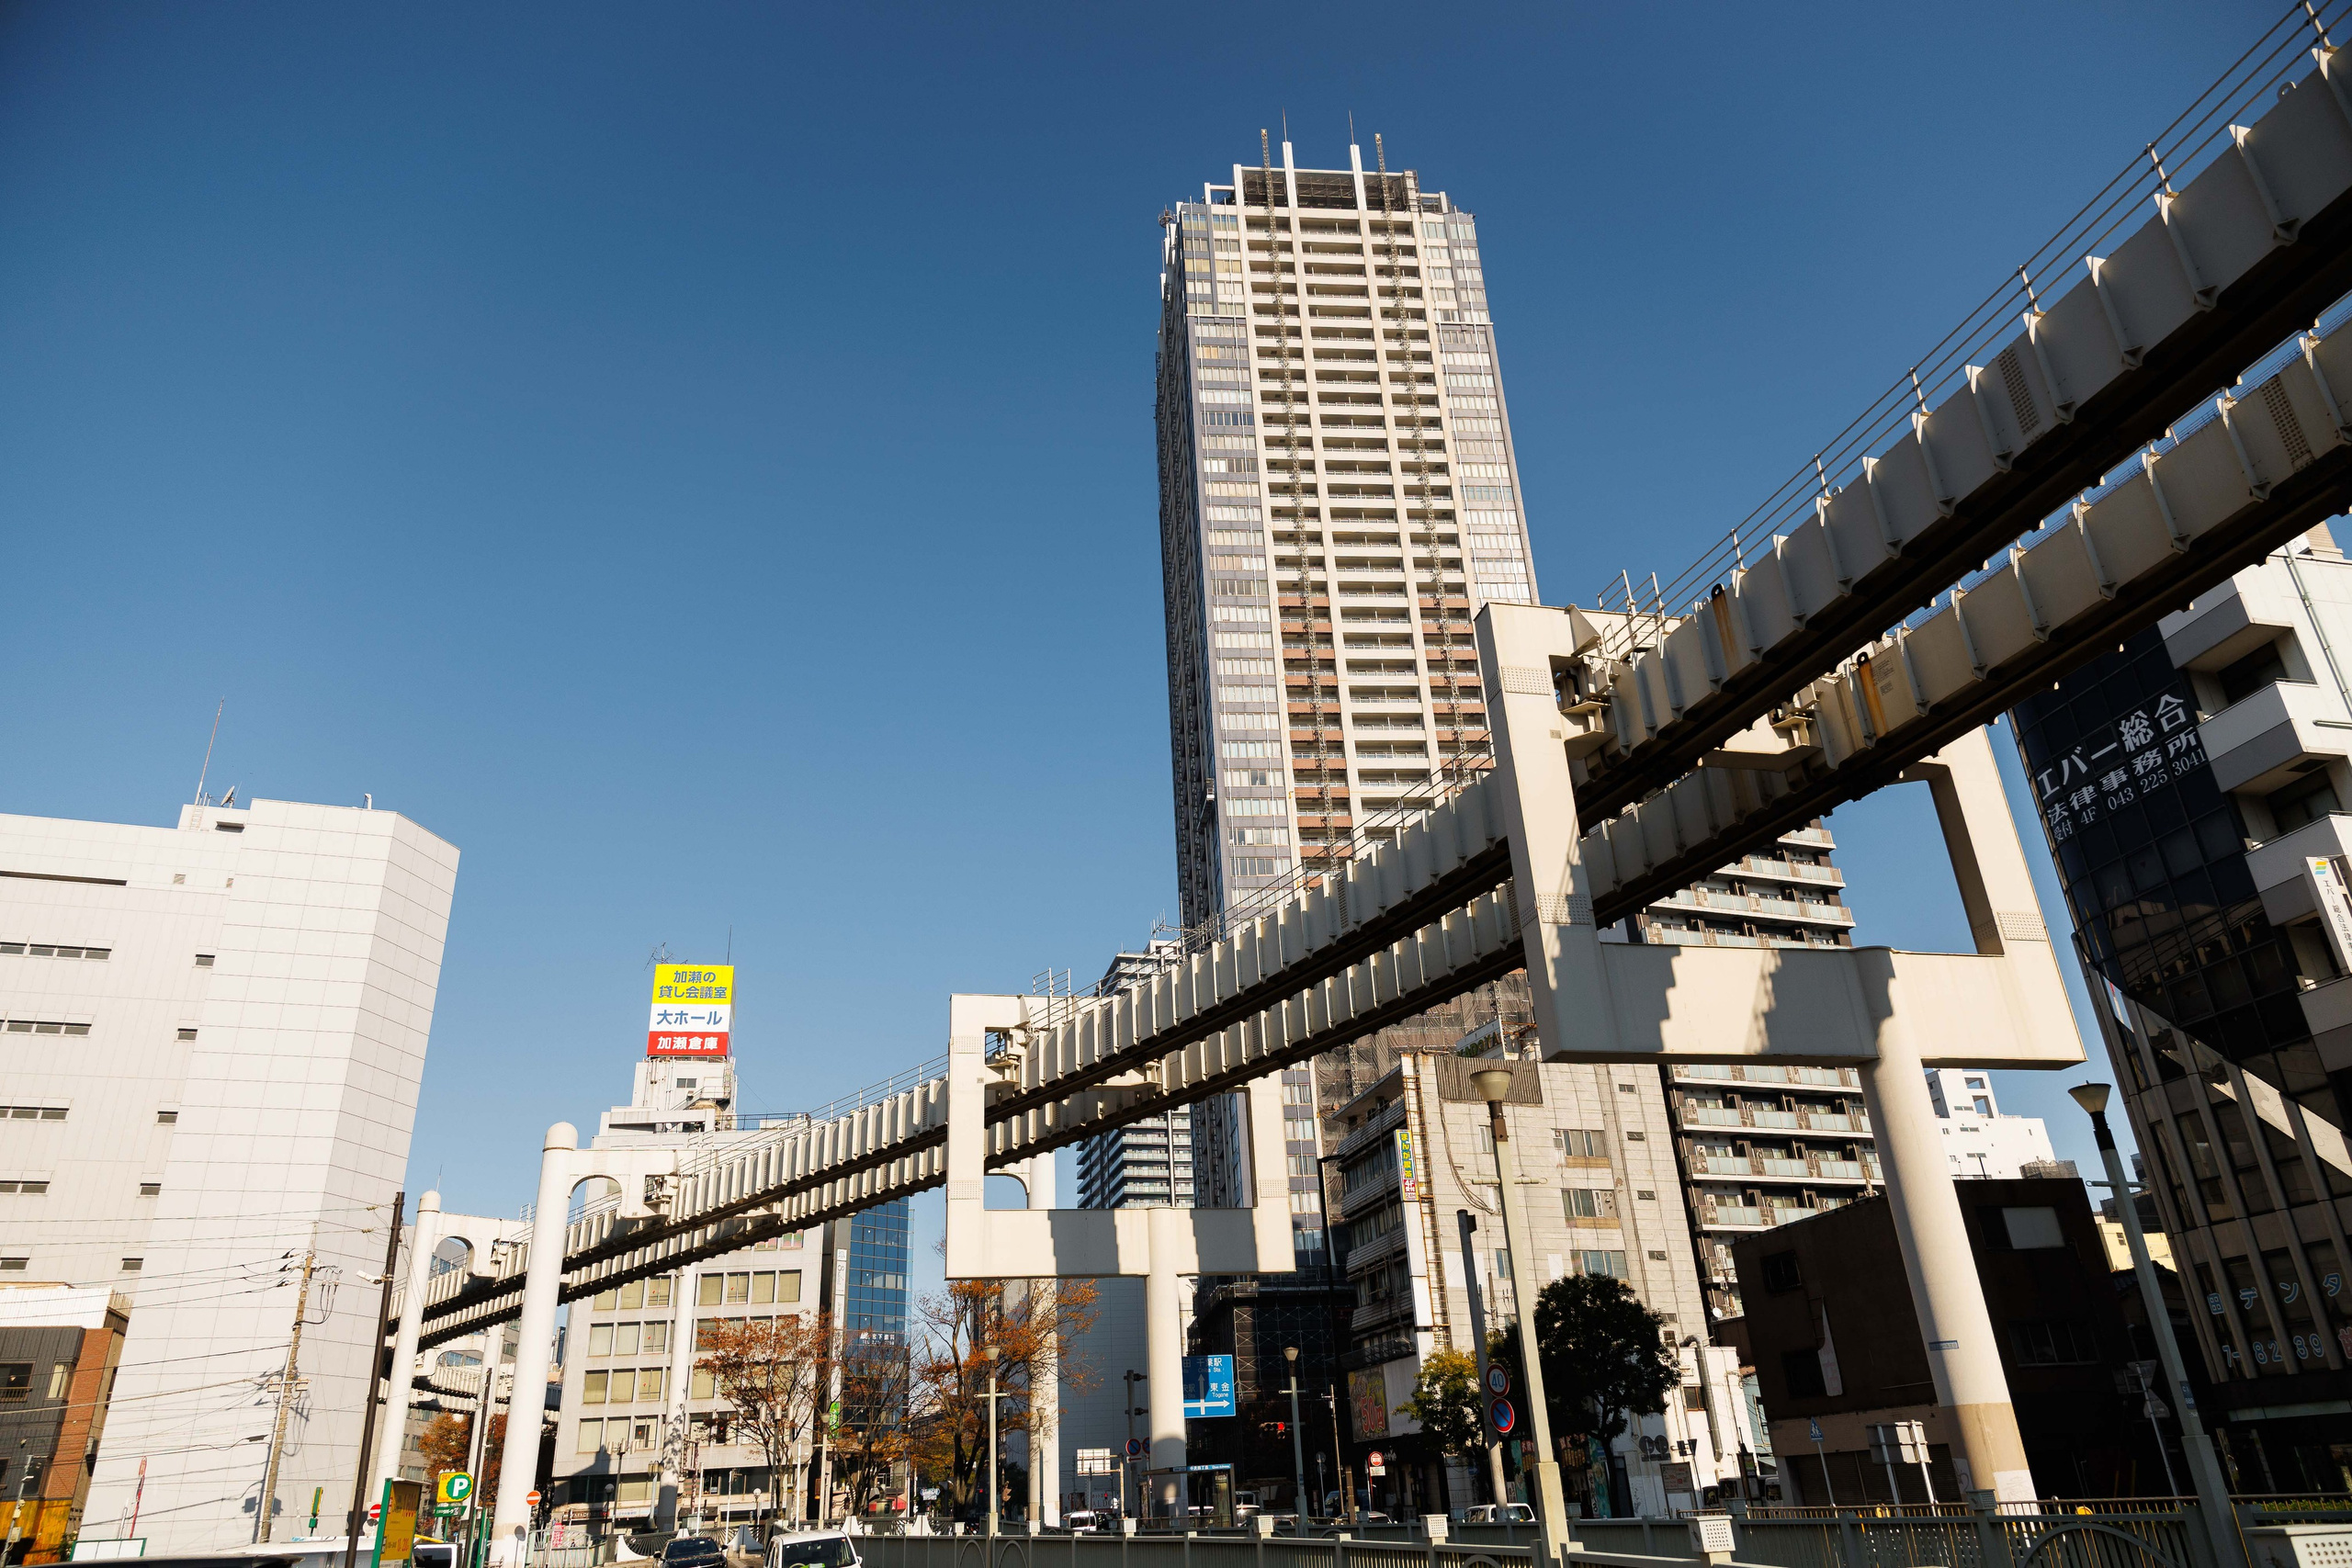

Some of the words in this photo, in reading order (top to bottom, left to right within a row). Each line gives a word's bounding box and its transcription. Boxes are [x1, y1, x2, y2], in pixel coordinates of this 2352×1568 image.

[2037, 694, 2187, 800] エバー総合
[2047, 727, 2198, 827] 法律事務所
[2053, 819, 2074, 842] 受付
[2080, 806, 2098, 825] 4F
[2108, 787, 2134, 810] 043
[2140, 768, 2168, 794] 225
[2172, 748, 2207, 776] 3041
[673, 971, 716, 983] 加瀬の
[659, 985, 728, 999] 貸し会議室
[656, 1010, 723, 1026] 大ホール
[657, 1036, 718, 1051] 加瀬倉庫
[1196, 1357, 1223, 1368] 千葉駅
[1210, 1382, 1230, 1392] 東金
[1491, 1373, 1505, 1388] 40
[453, 1478, 468, 1496] P
